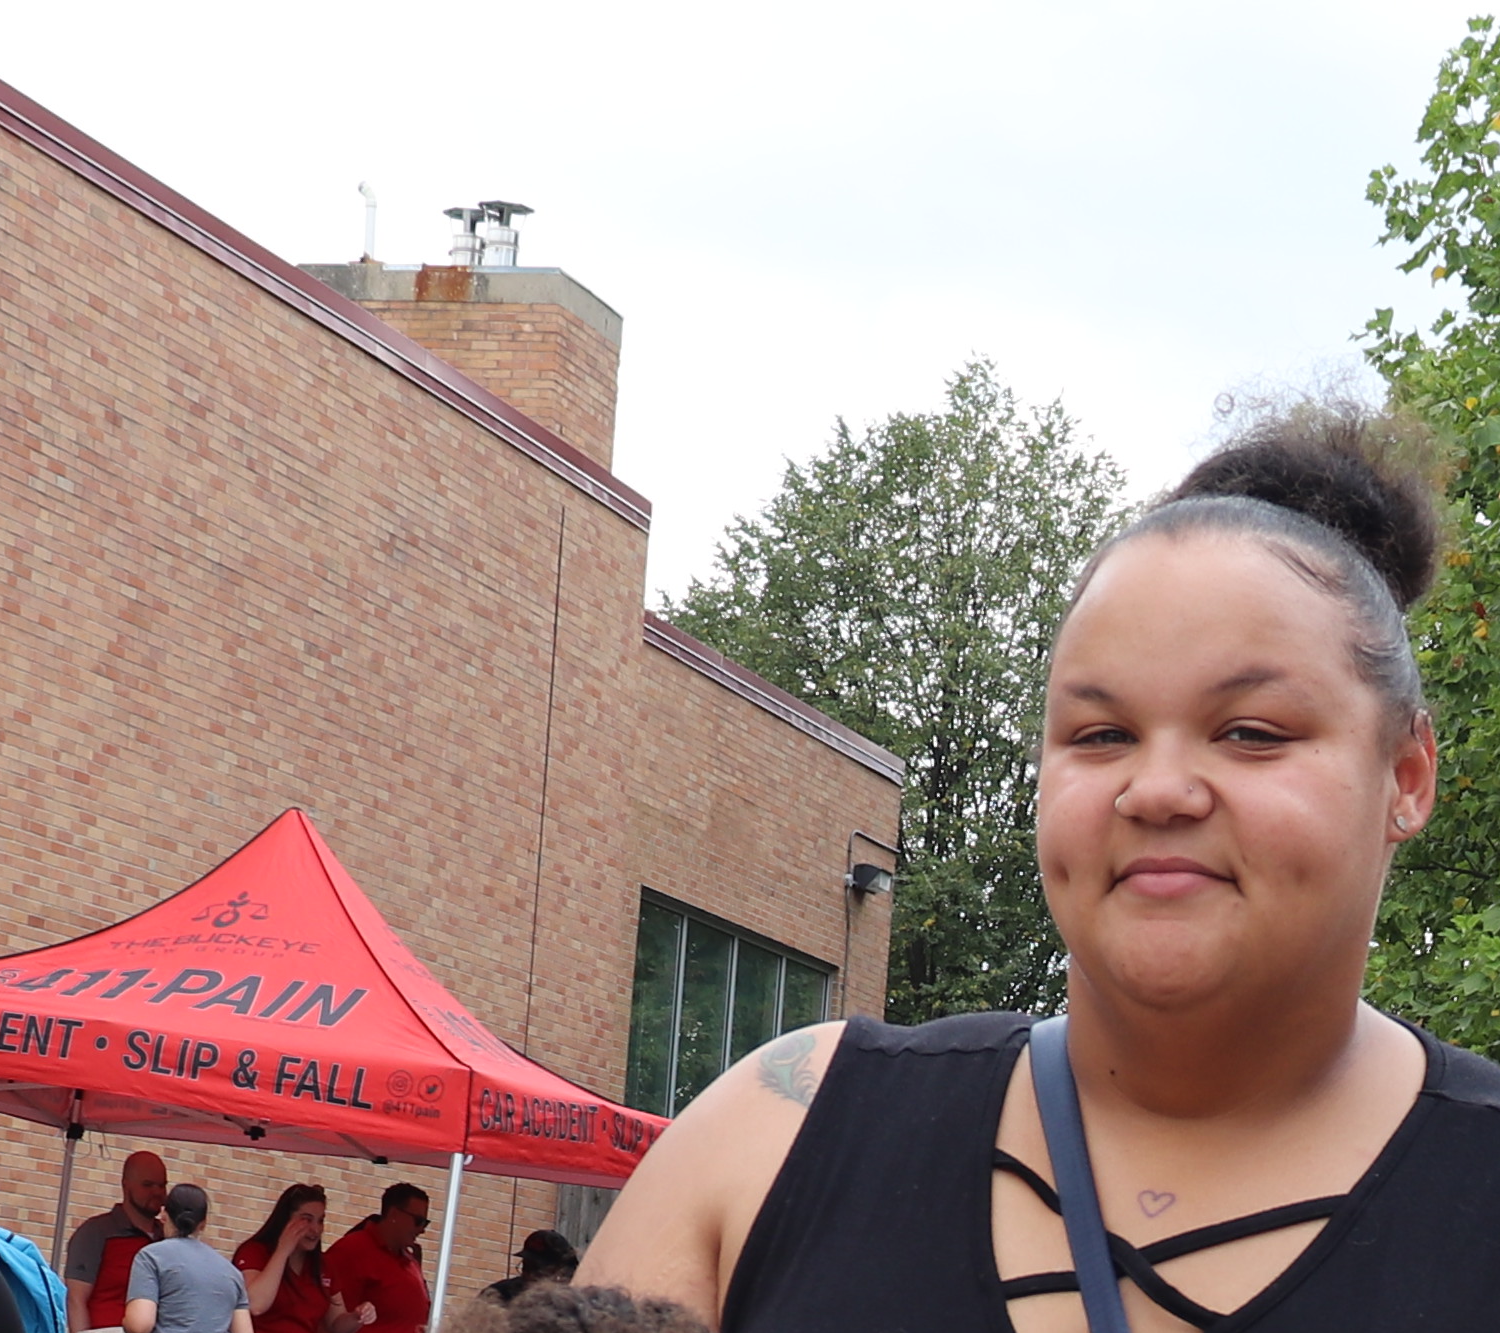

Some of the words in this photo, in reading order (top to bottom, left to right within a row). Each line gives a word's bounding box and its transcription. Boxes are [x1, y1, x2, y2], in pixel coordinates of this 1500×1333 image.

[122, 1029, 221, 1081] SLIP
[231, 1048, 259, 1092] &
[273, 1054, 373, 1111] FALL
[479, 1088, 516, 1131] CAR
[520, 1096, 600, 1144] ACCIDENT
[610, 1112, 644, 1151] SLIP
